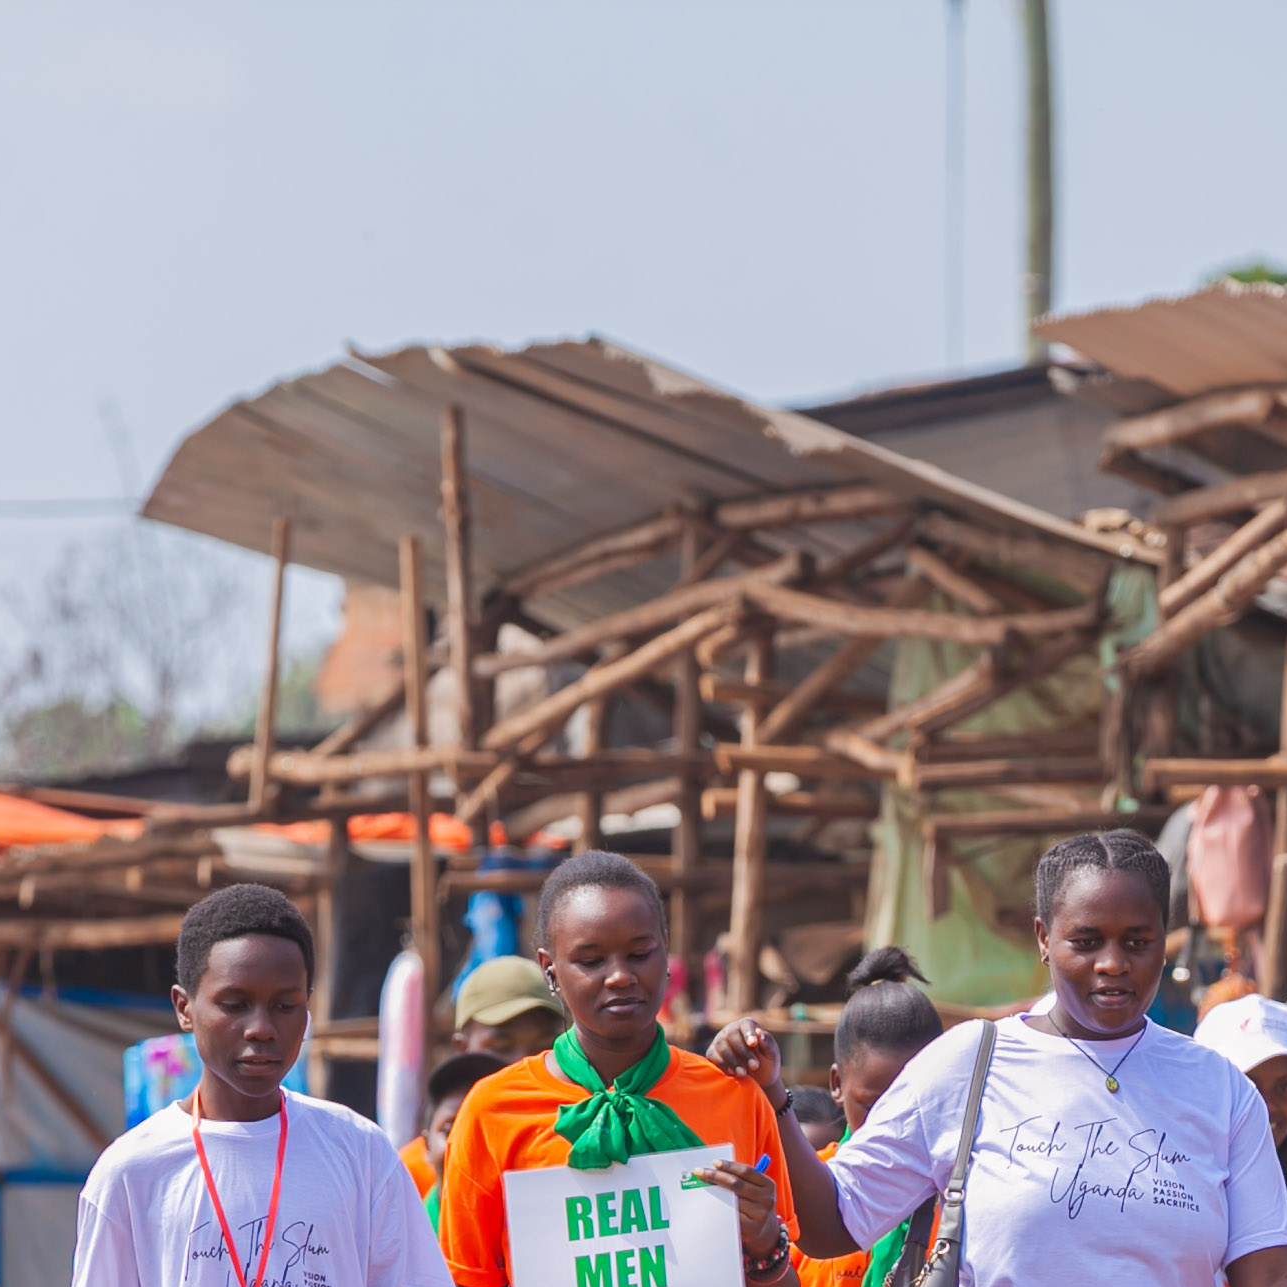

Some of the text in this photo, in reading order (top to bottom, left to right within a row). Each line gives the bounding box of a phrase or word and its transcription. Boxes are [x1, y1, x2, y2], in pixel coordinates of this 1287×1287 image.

[999, 1114, 1192, 1174] Touch The Slum
[1050, 1163, 1145, 1220] Uganda
[1152, 1178, 1185, 1191] VISION
[1152, 1187, 1194, 1202] PASSION
[564, 1185, 671, 1242] REAL
[1152, 1196, 1200, 1213] SACRIFICE
[184, 1215, 330, 1282] Touch Th Slum
[303, 1270, 326, 1283] VSION
